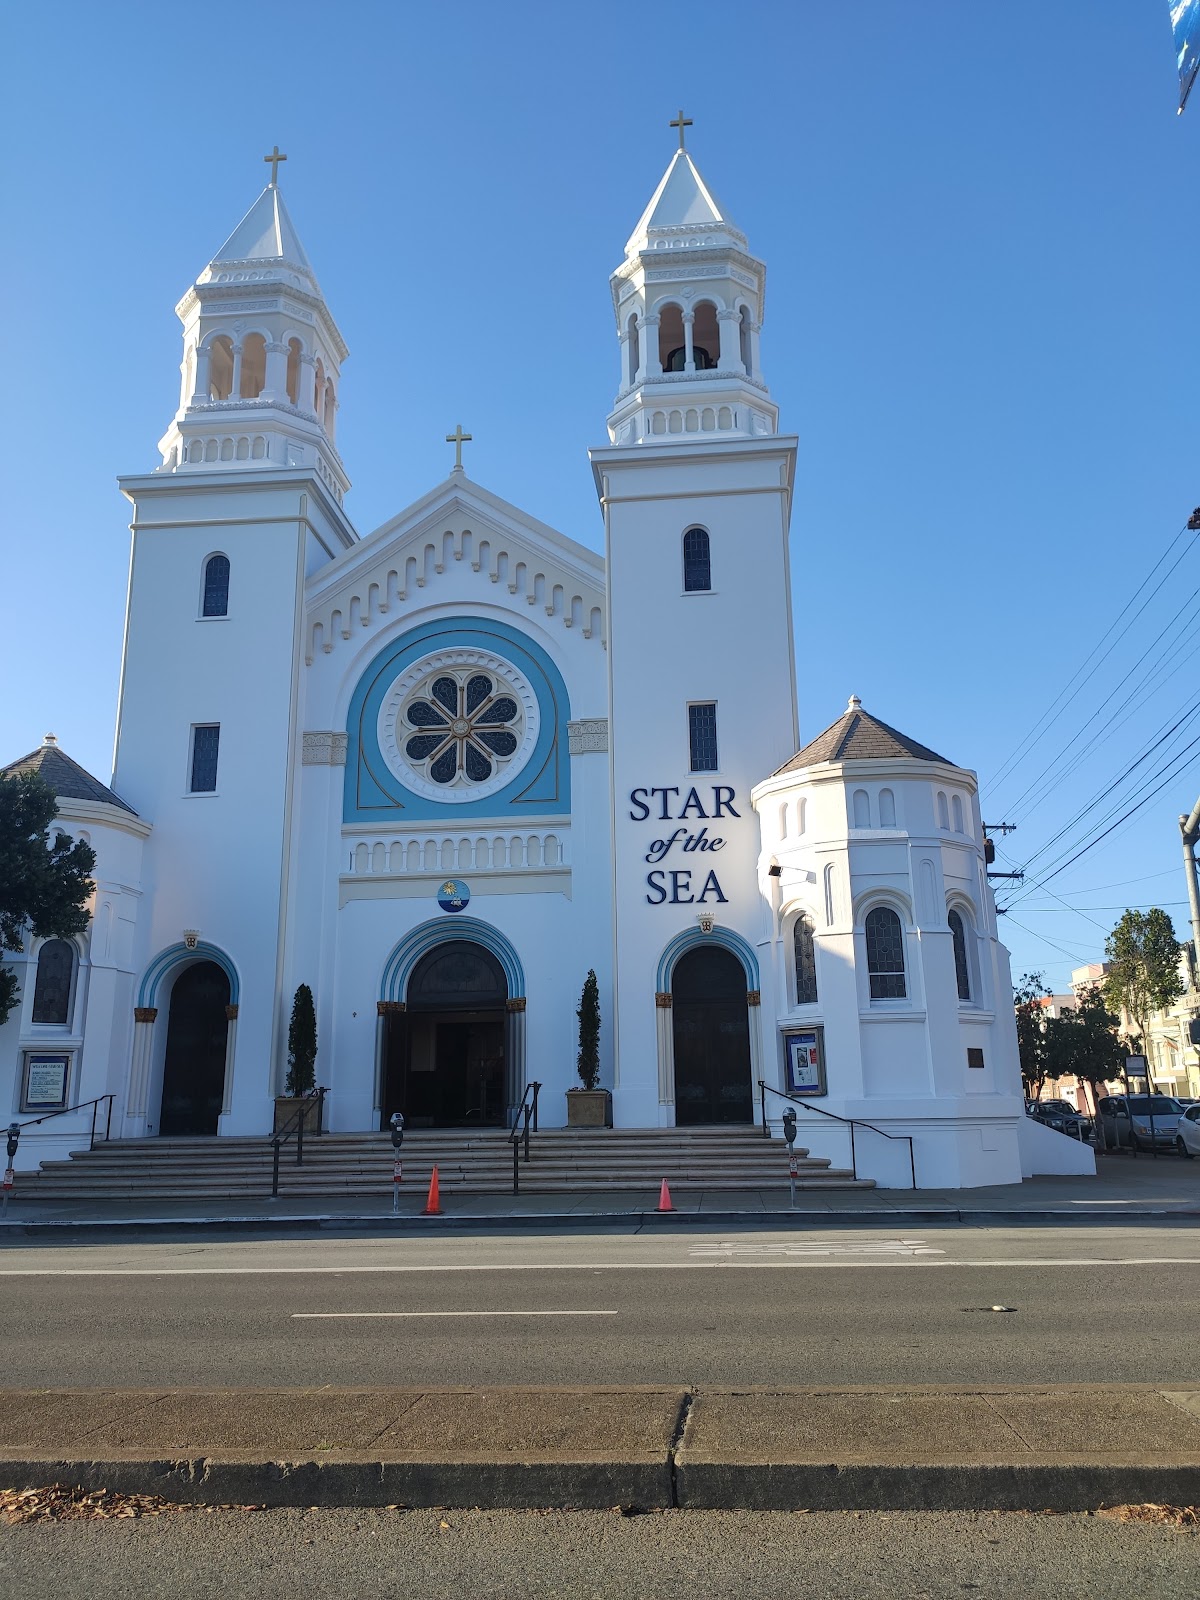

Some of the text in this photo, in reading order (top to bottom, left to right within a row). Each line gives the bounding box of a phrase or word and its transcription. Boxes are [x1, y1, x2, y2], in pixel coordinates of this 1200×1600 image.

[629, 786, 741, 822] STAR
[645, 827, 727, 864] of the
[646, 869, 729, 905] SEA
